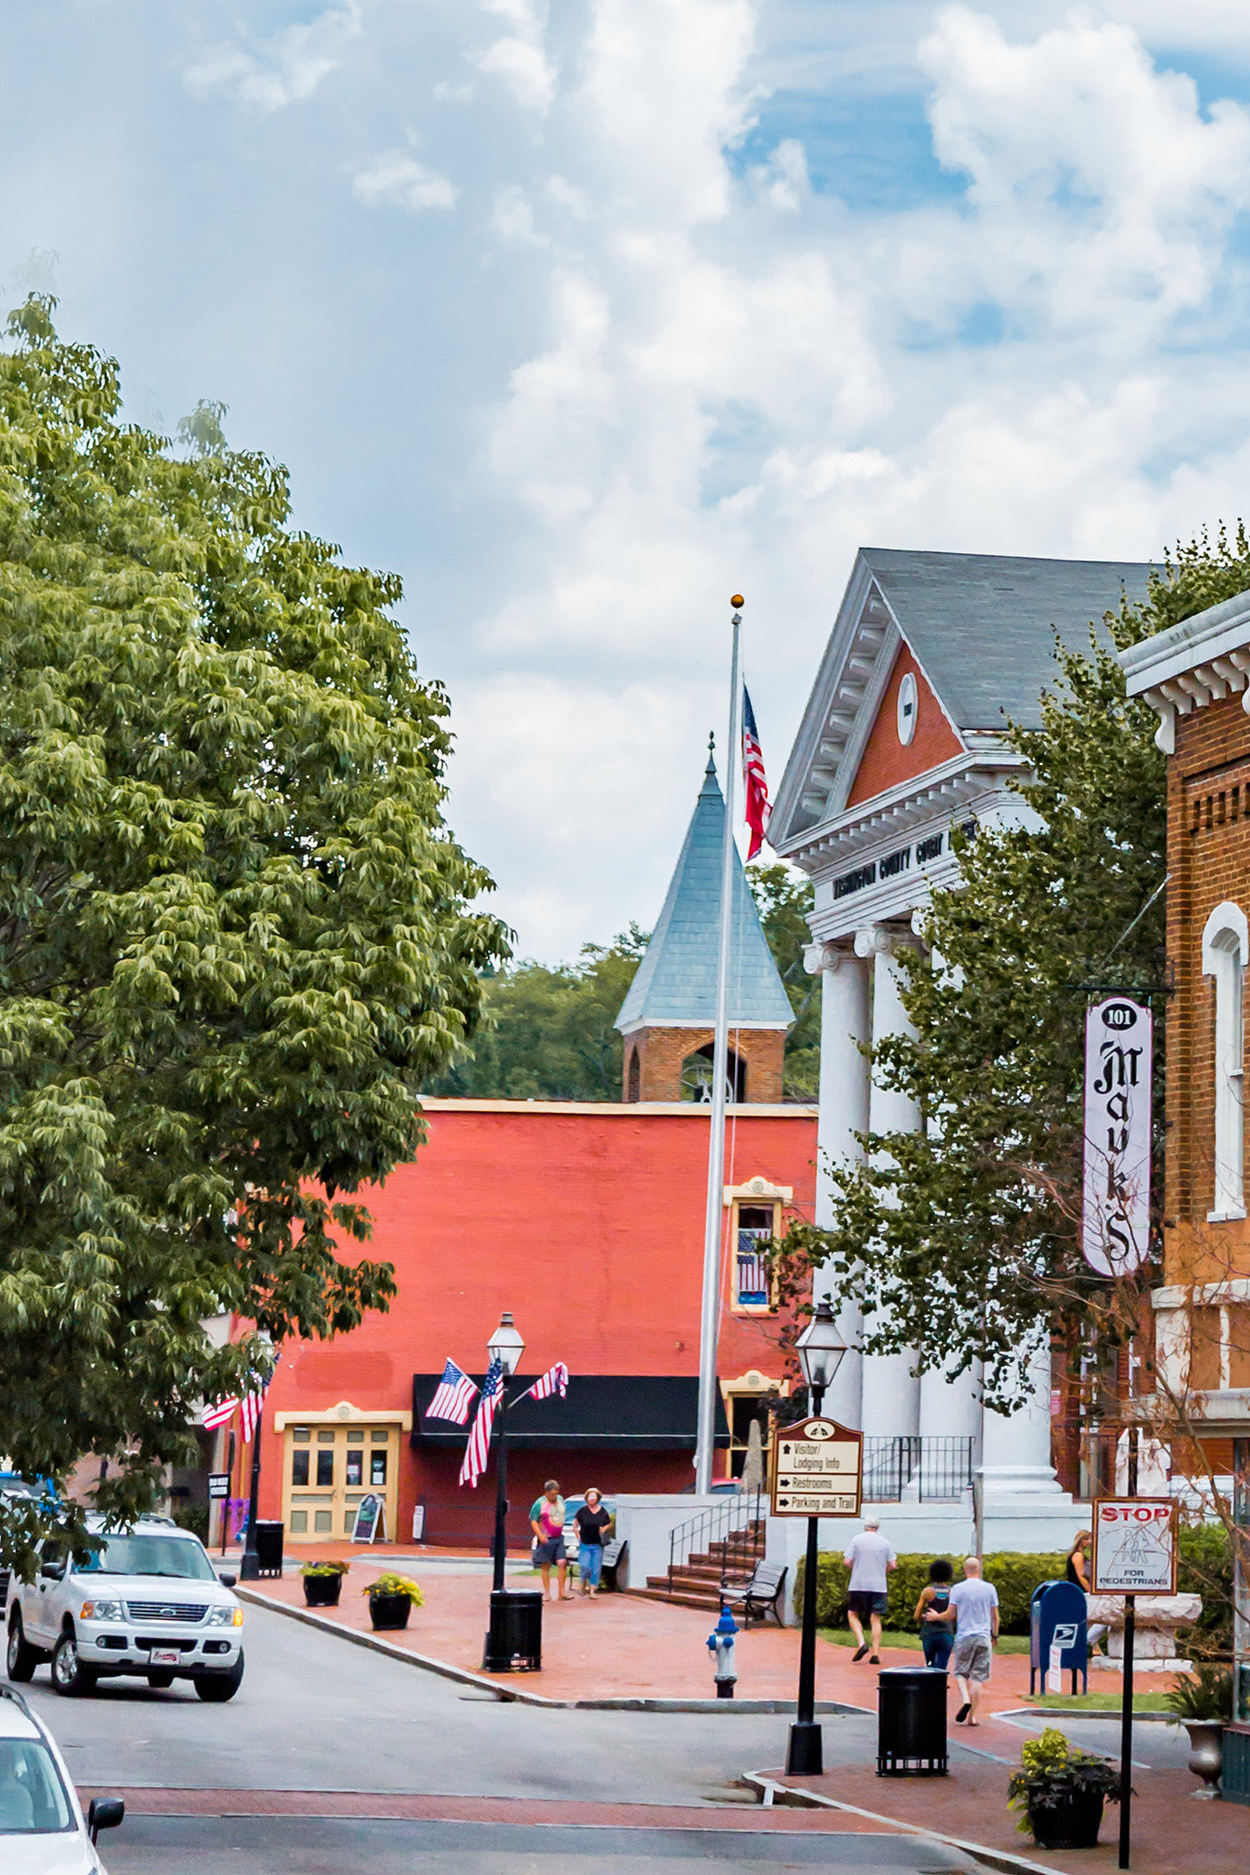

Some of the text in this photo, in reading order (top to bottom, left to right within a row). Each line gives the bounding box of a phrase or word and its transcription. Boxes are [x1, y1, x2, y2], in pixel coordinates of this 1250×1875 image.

[1106, 1009, 1132, 1025] 101
[793, 1457, 840, 1471] Lodging Info
[792, 1477, 832, 1489] Restrooms
[791, 1496, 855, 1511] Parking and Trail
[1101, 1507, 1170, 1522] STOP
[1123, 1569, 1145, 1577] FOR
[1099, 1577, 1168, 1585] PEDESTRIANS
